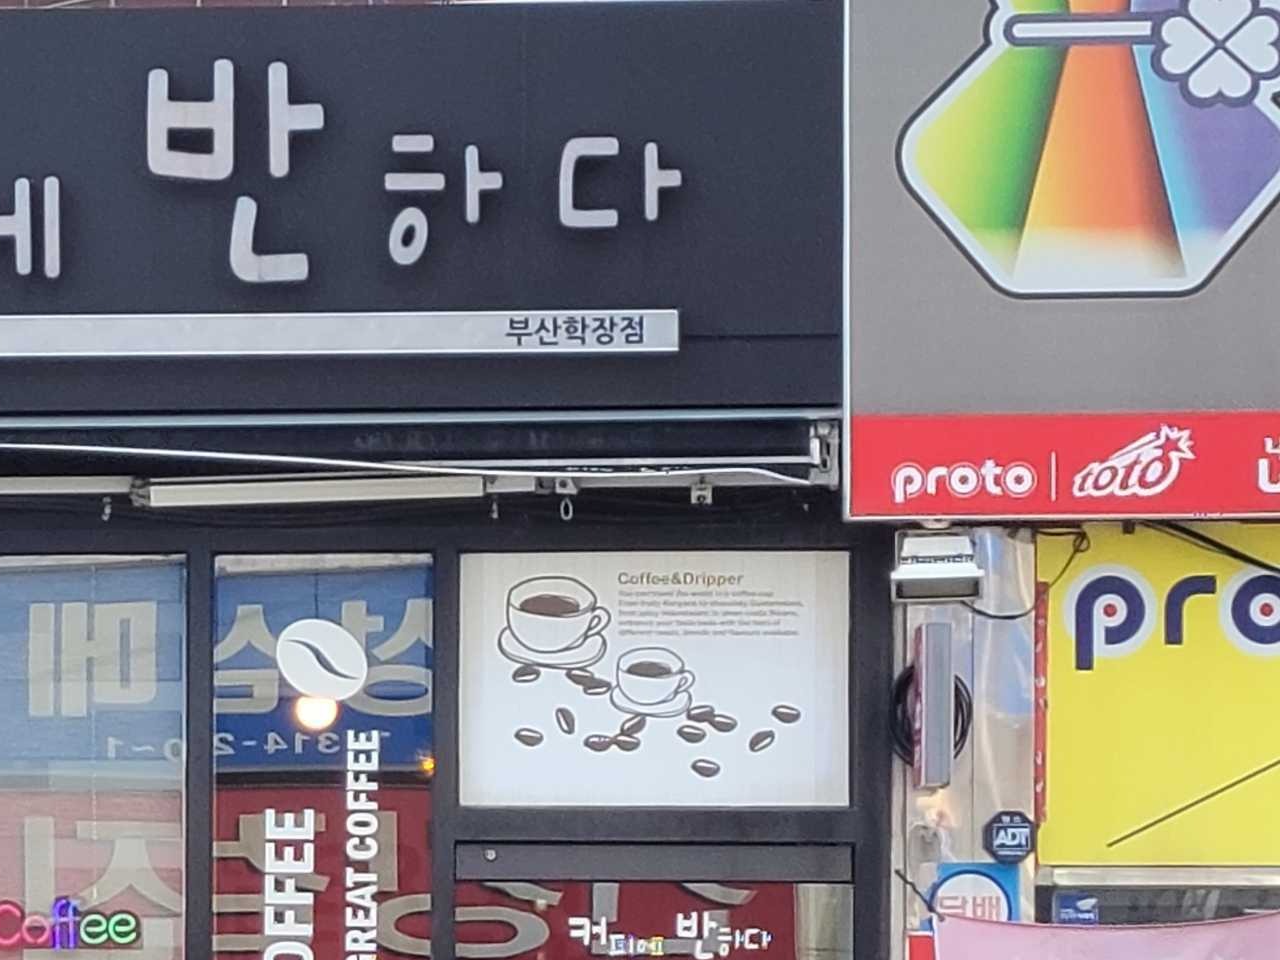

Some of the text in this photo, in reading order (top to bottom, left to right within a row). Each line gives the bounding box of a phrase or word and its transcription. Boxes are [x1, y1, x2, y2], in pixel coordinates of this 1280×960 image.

[146, 58, 683, 283] 반하다
[504, 313, 646, 346] 부산학장점
[891, 459, 1038, 503] proto
[345, 729, 381, 861] COFFEE
[993, 827, 1031, 847] ADT
[568, 911, 773, 960] 커피에 반하다
